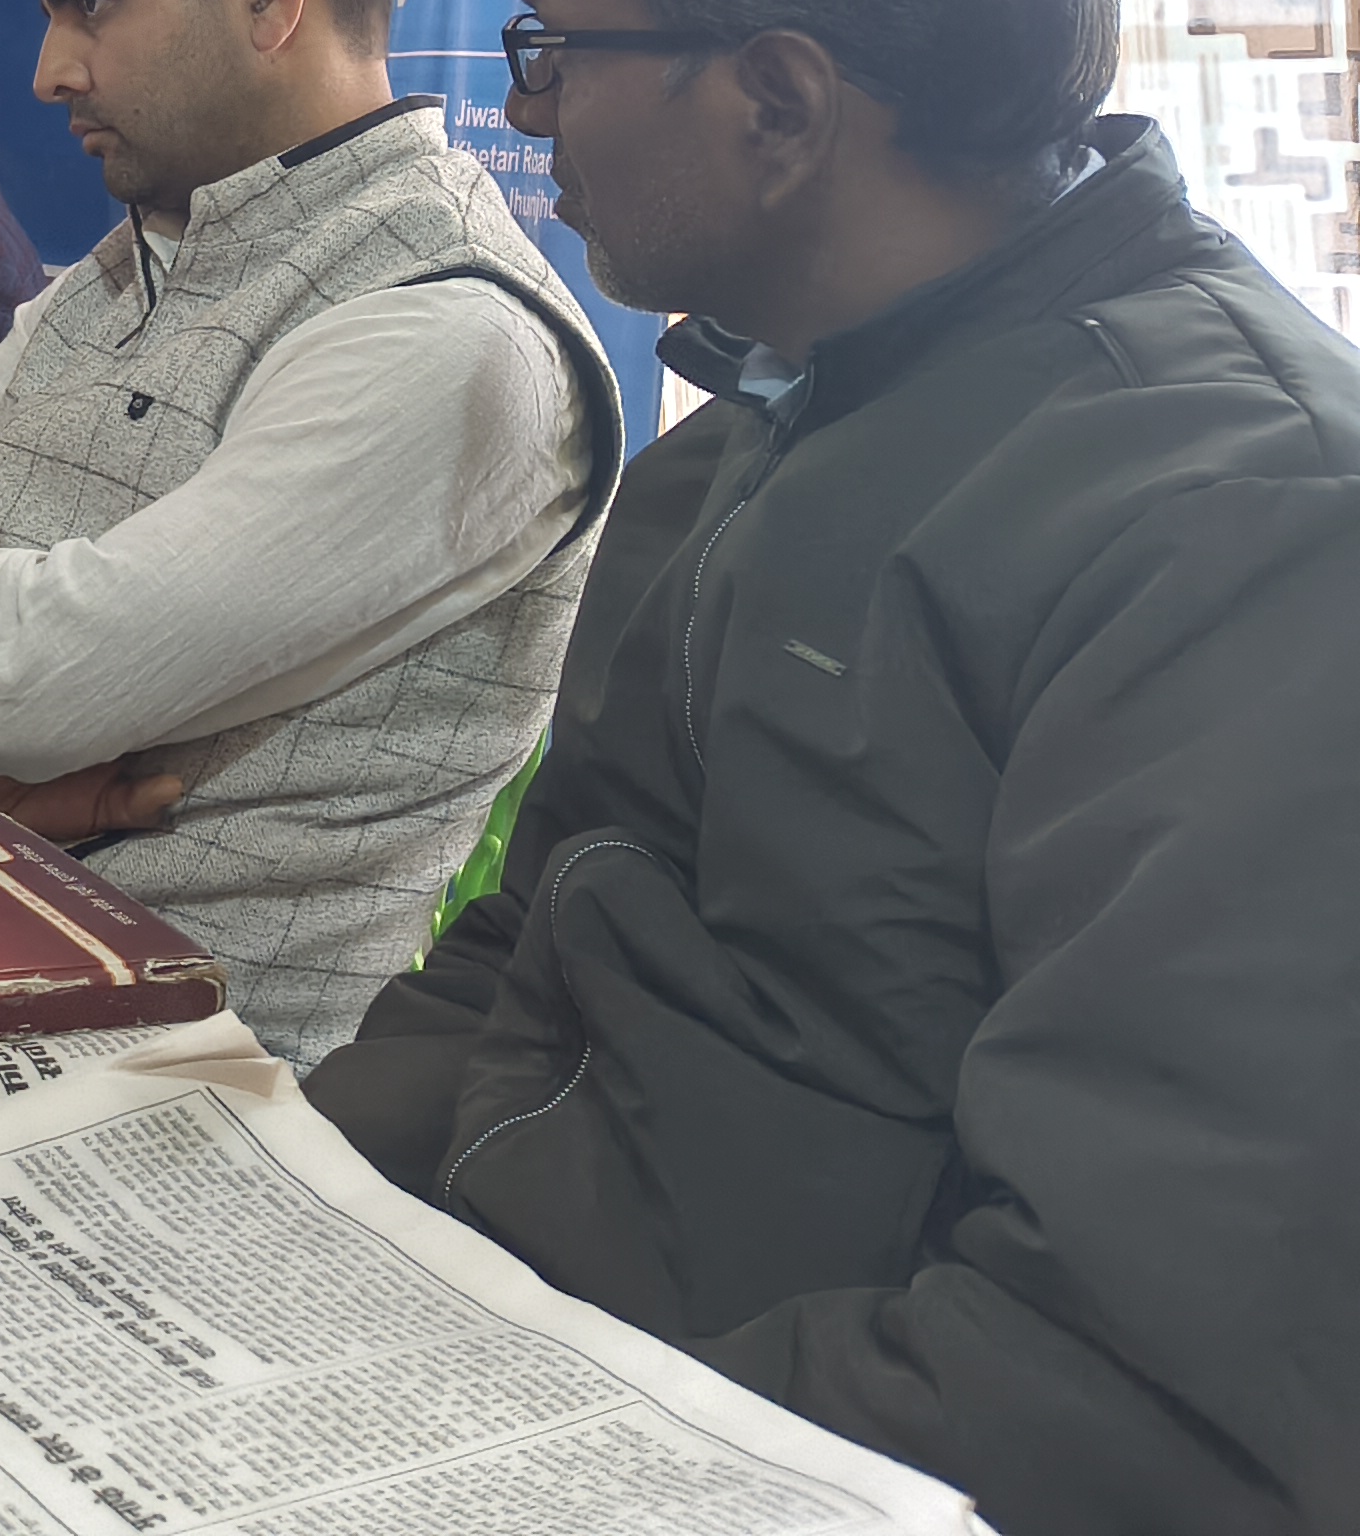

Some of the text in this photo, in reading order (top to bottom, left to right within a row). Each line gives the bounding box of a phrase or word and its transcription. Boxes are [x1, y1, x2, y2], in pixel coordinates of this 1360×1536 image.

[1, 1195, 43, 1230] आदेश
[32, 1432, 84, 1466] लिए
[68, 1464, 103, 1485] के
[92, 1486, 167, 1532] मुनाफे
